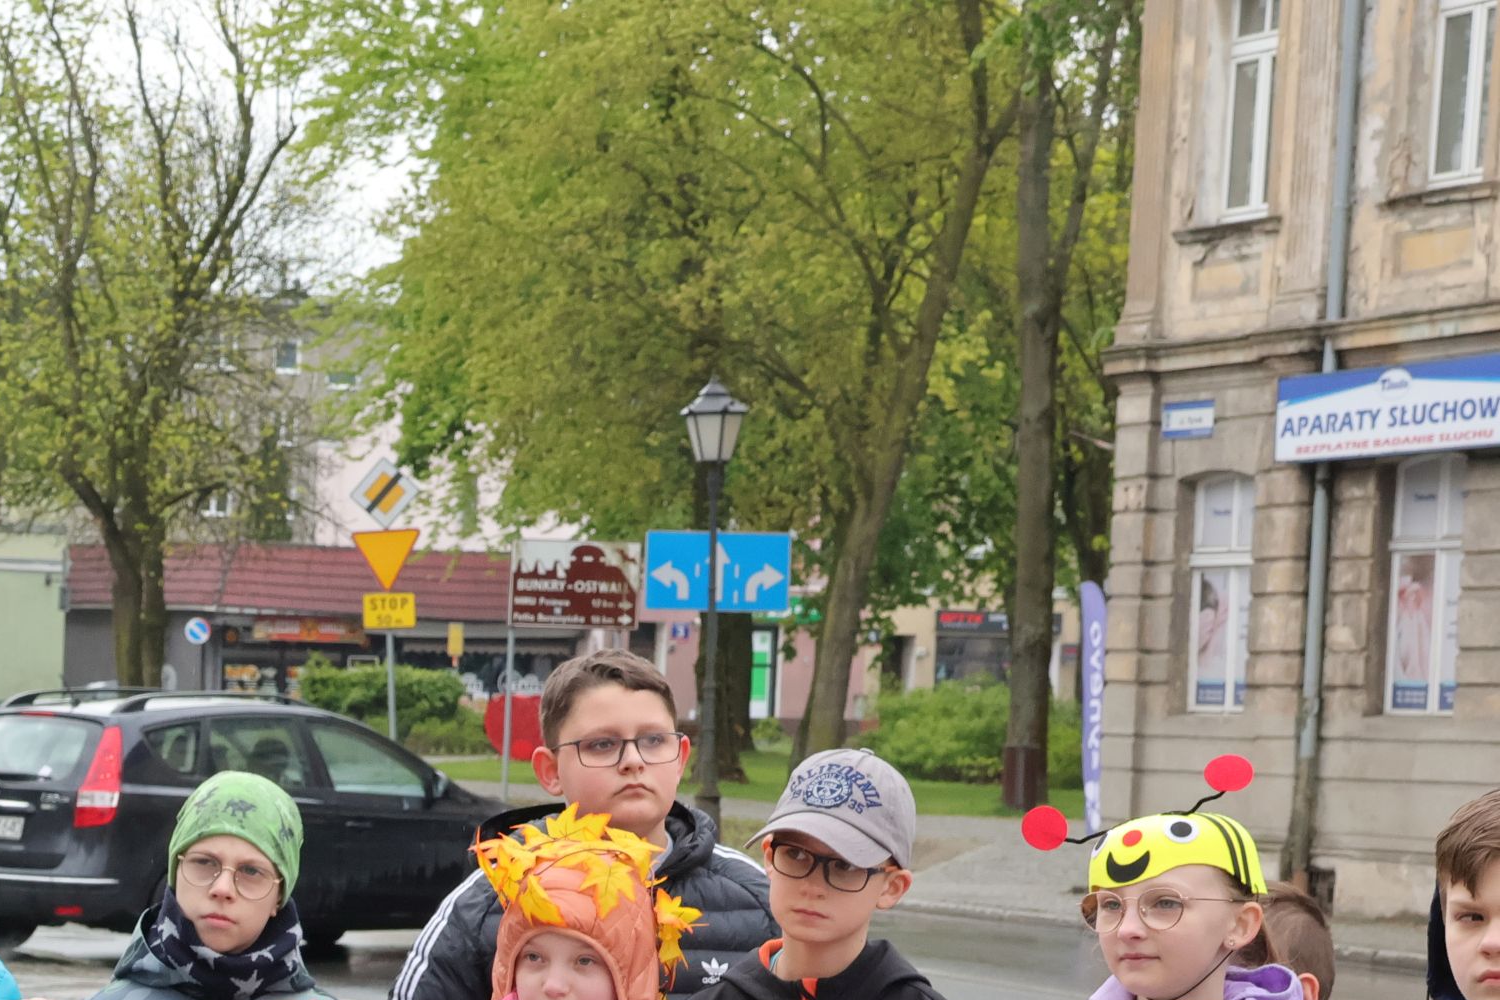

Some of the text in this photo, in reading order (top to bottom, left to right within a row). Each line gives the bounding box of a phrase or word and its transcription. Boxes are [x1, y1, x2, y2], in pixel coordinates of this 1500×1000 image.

[1280, 408, 1381, 439] APARATY
[1373, 434, 1434, 450] BADANIE
[370, 597, 408, 611] STOP
[790, 763, 882, 809] CALIFORNIA
